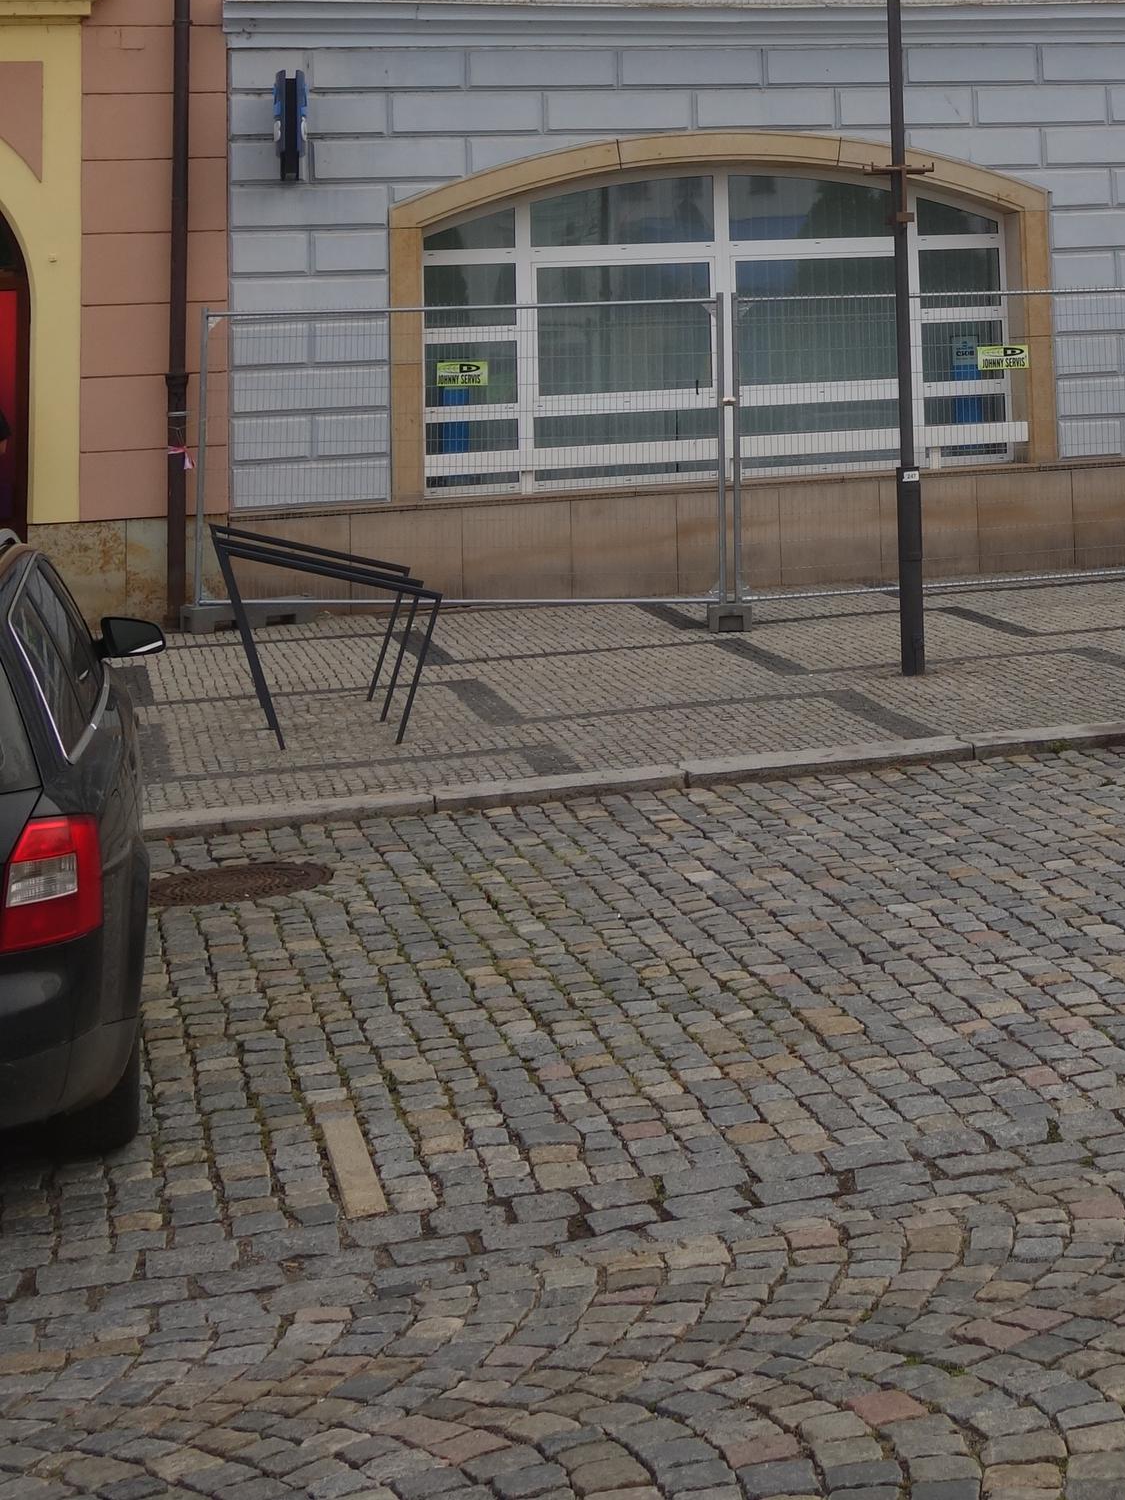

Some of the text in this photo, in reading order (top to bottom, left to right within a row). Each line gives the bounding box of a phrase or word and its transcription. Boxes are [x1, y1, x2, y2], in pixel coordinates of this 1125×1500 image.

[982, 357, 1026, 369] JOHNNY SERVIS
[438, 374, 481, 384] JOHNNY SERVIS
